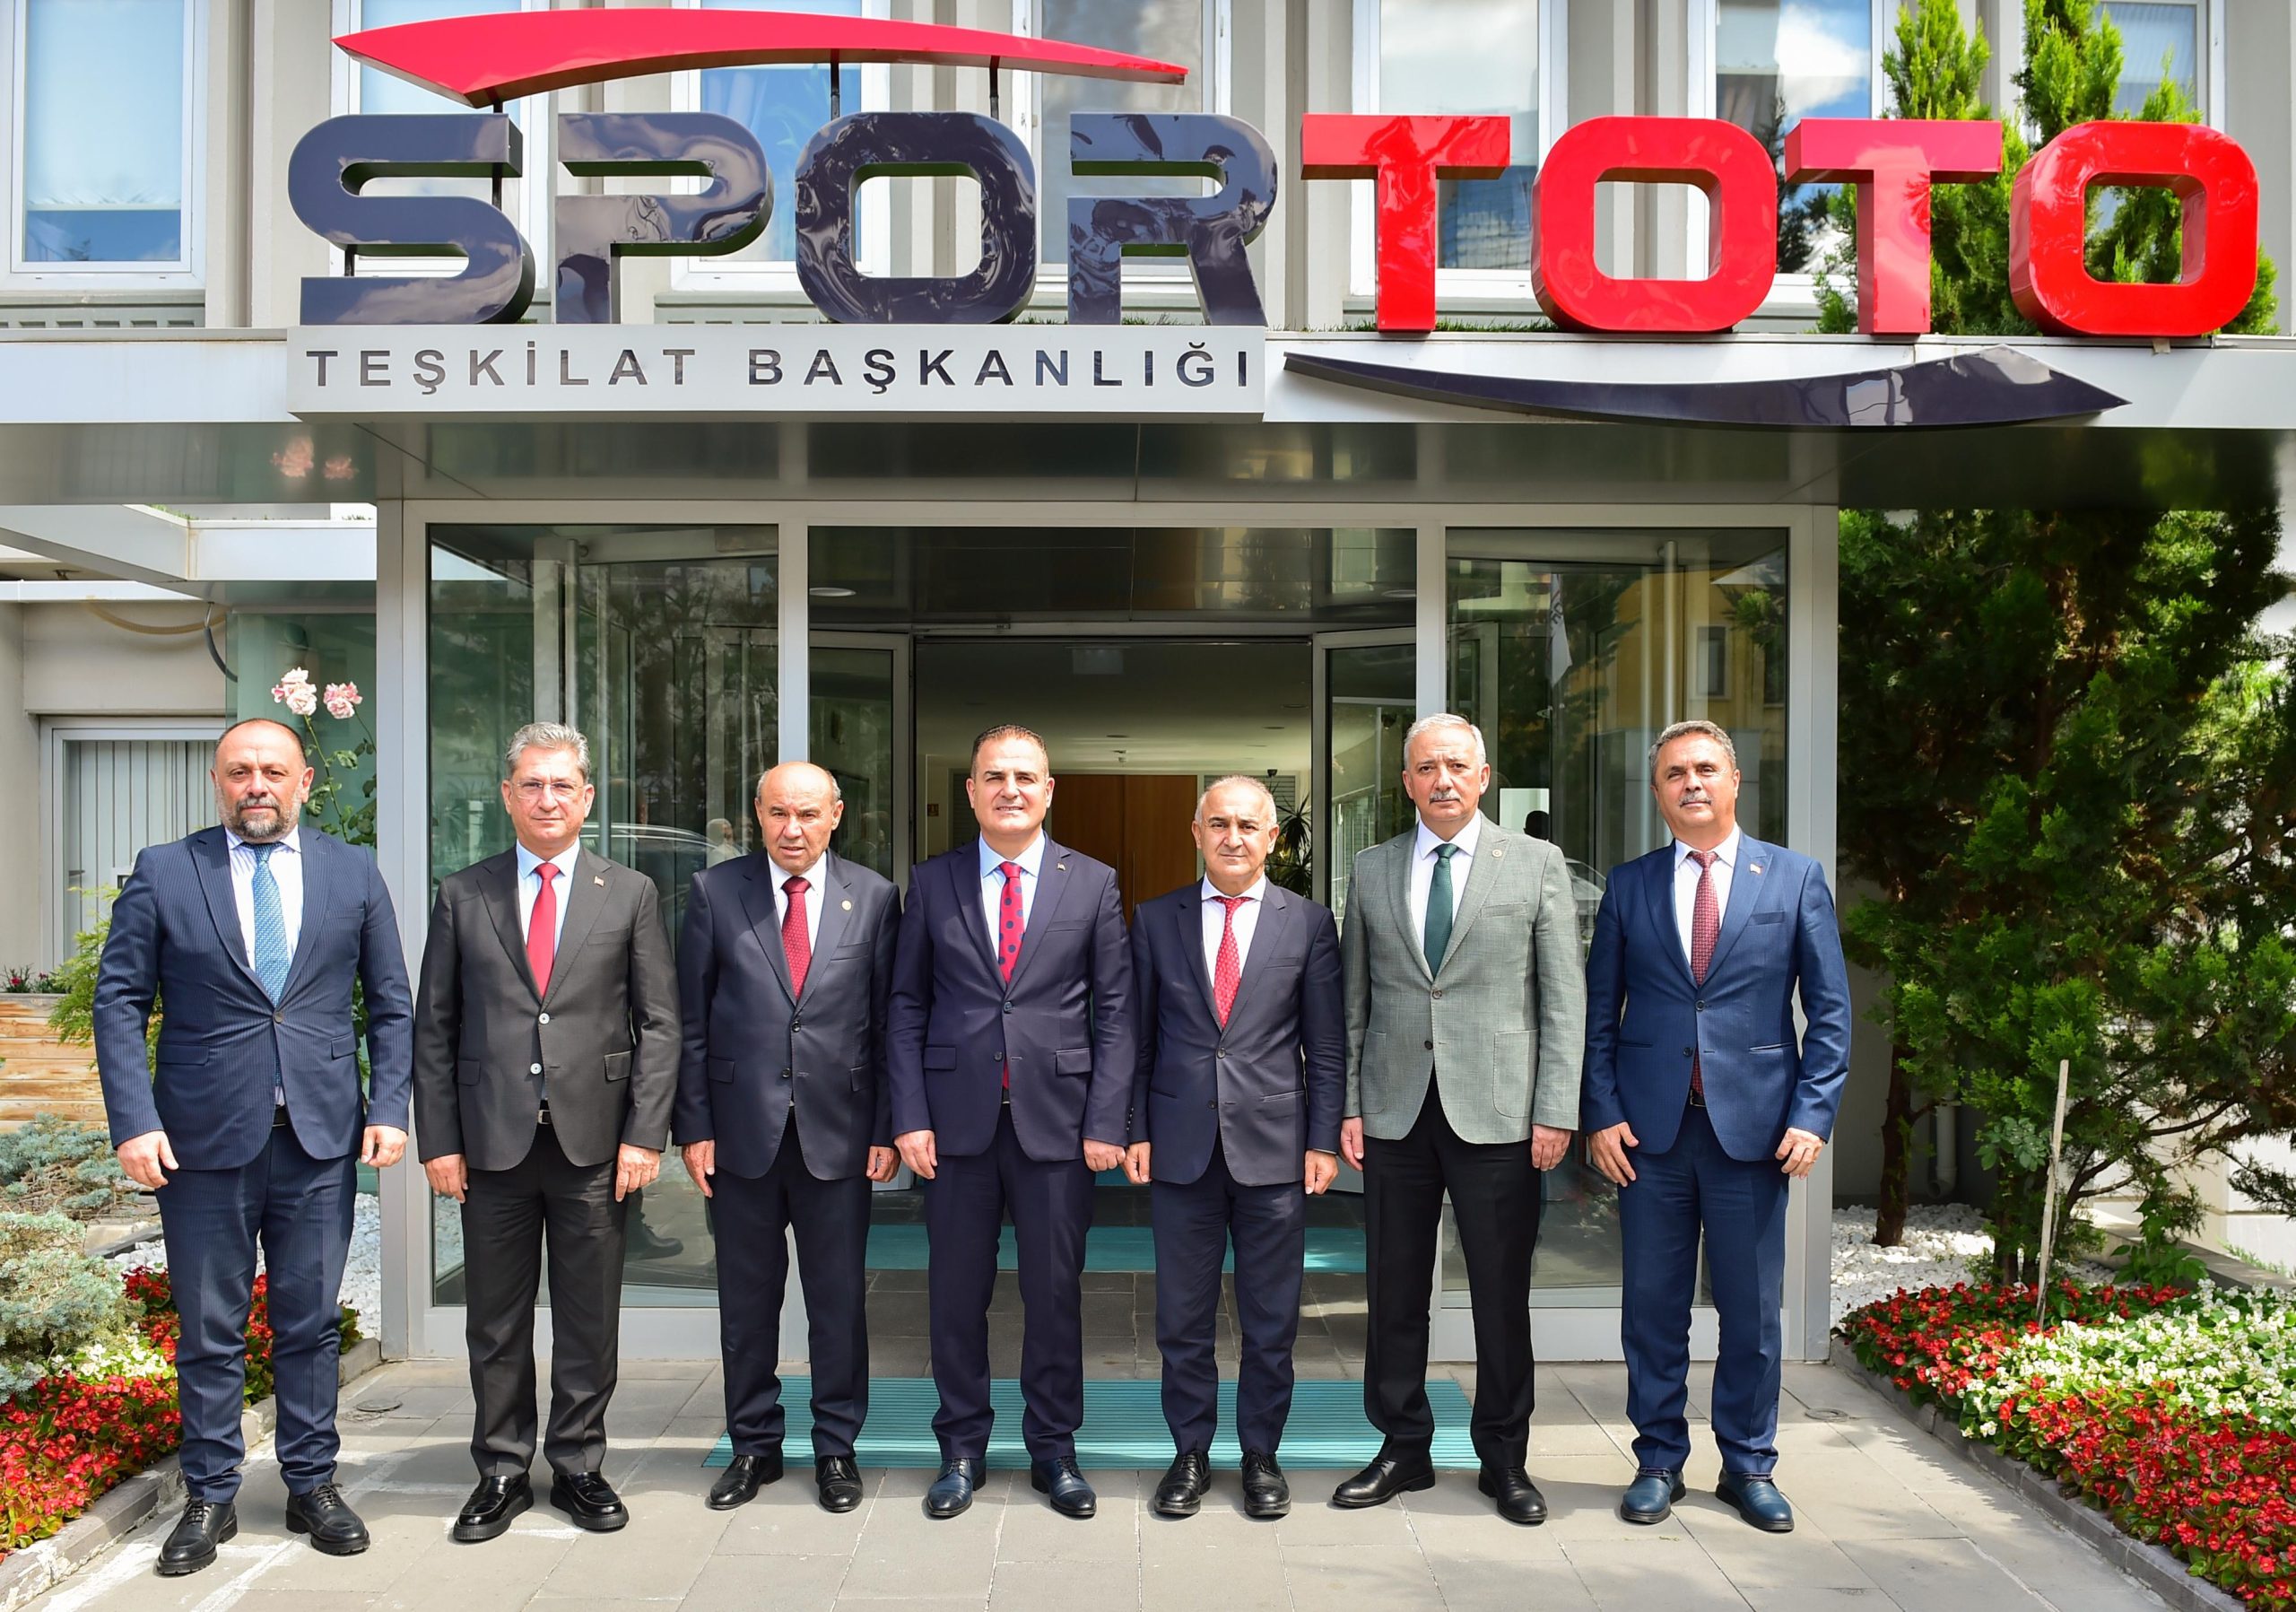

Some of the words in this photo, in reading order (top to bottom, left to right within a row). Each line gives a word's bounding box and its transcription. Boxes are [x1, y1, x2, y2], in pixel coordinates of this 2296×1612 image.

[288, 111, 1278, 326] SPOR
[1301, 113, 2259, 338] TOTO
[305, 340, 697, 396] TEŞKİLAT
[748, 341, 1248, 396] BAŞKANLIĞI
